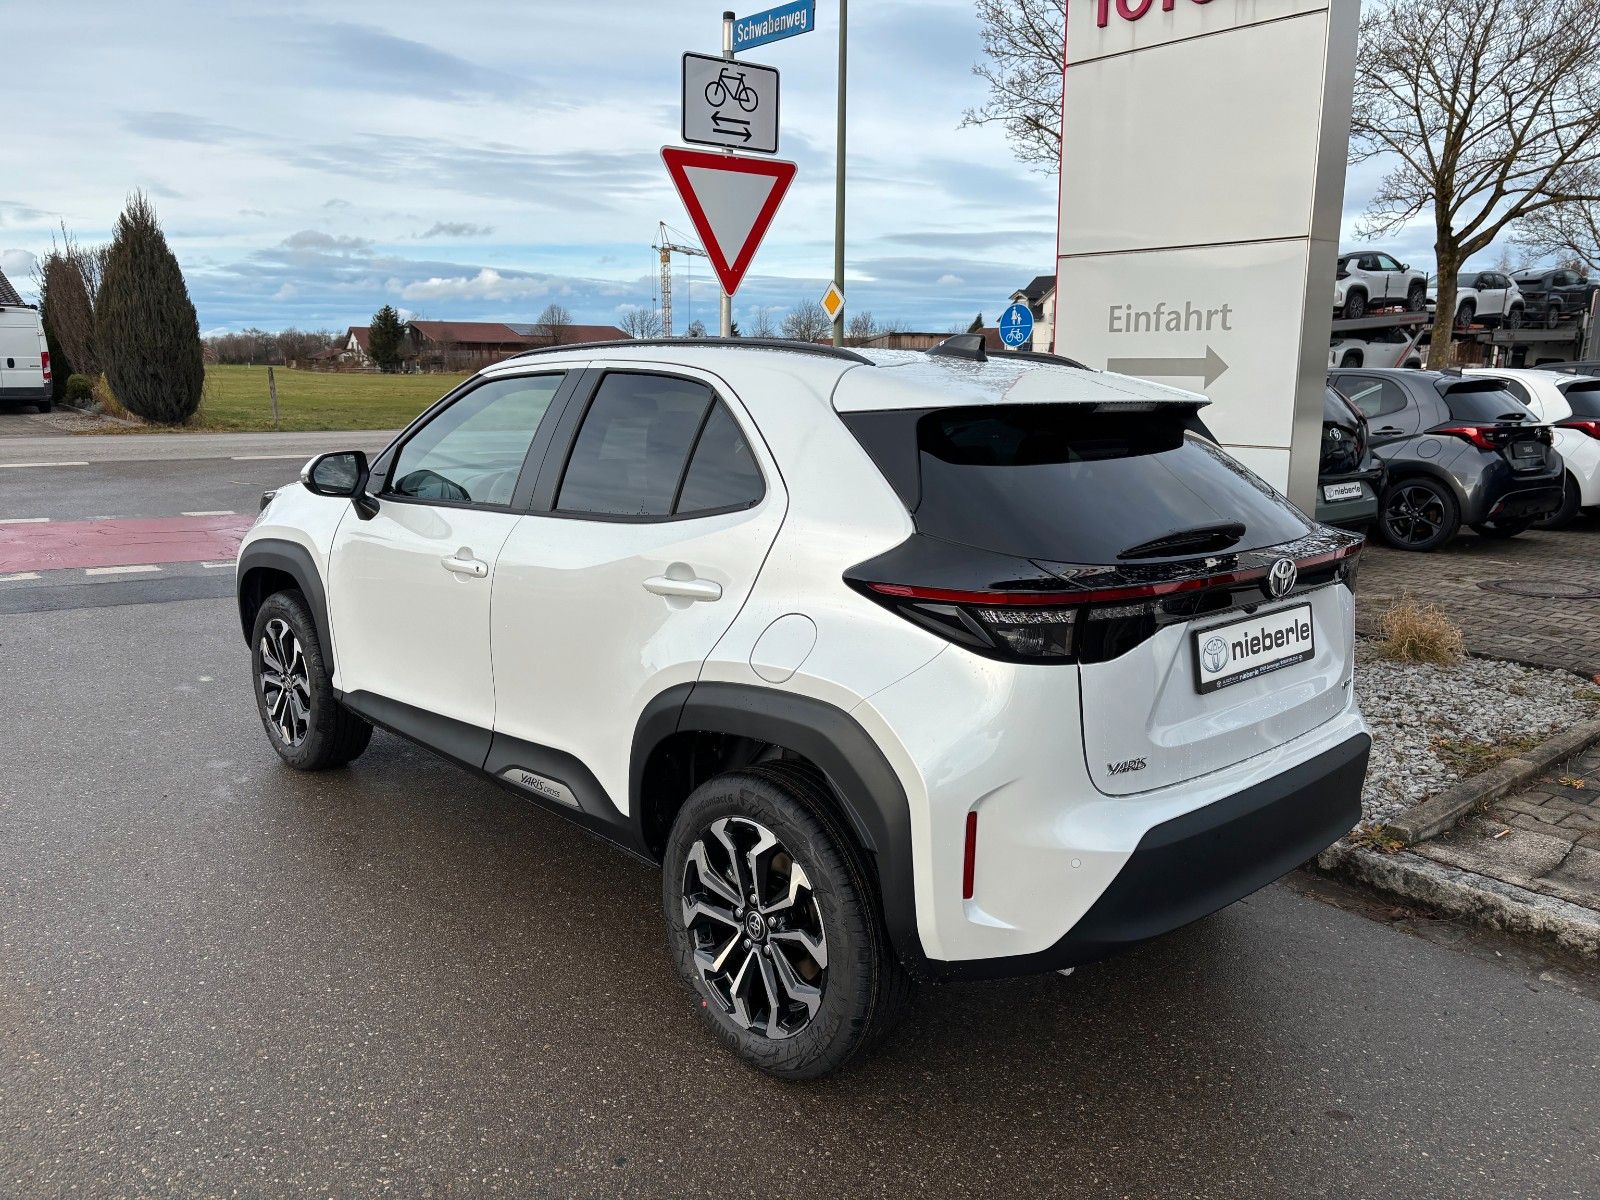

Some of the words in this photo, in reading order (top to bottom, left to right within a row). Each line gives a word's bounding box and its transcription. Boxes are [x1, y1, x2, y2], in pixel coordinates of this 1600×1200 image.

[737, 8, 807, 43] Schwabenweg
[1108, 301, 1233, 333] Einfahrt
[1231, 618, 1310, 661] nieberle
[520, 773, 545, 791] YARIS
[1107, 757, 1147, 777] YARIS
